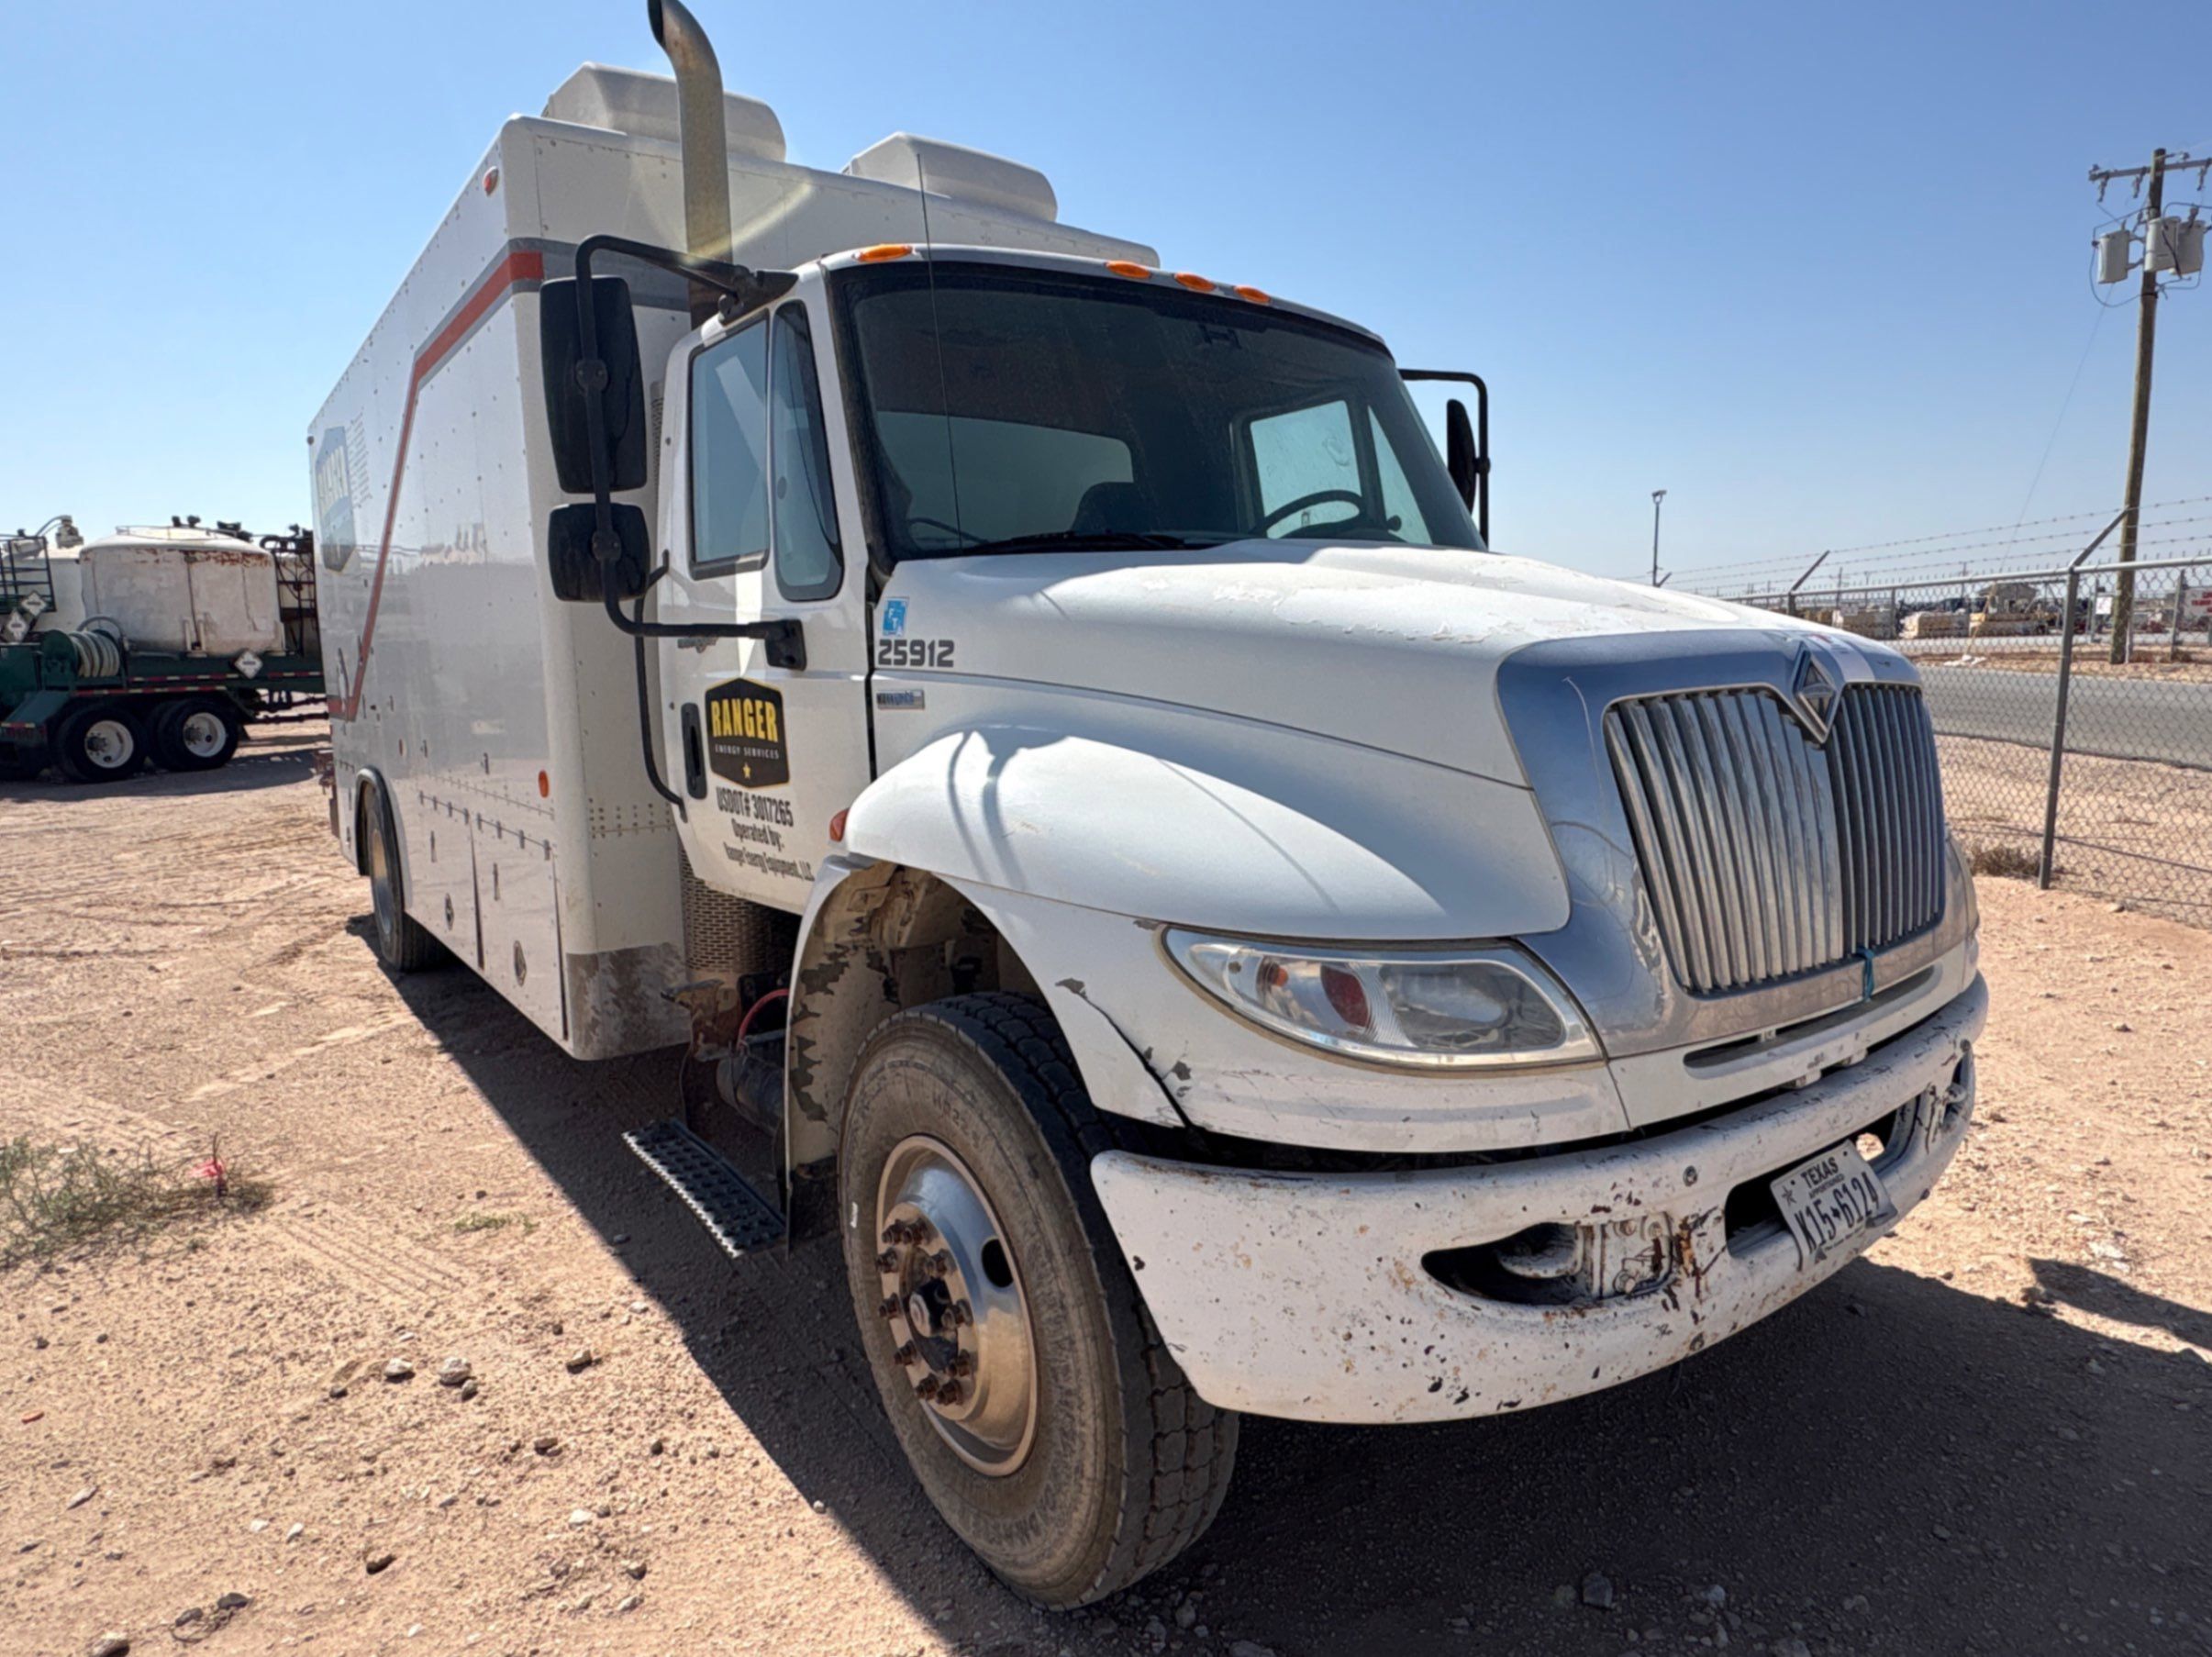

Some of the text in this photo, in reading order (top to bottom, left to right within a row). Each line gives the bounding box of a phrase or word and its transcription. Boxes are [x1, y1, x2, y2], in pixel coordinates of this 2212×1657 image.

[878, 639, 955, 668] 25912
[711, 698, 778, 742] RANGER
[743, 746, 780, 760] SERVICES
[751, 794, 795, 828] 3017265
[1800, 1156, 1840, 1190] TEXAS
